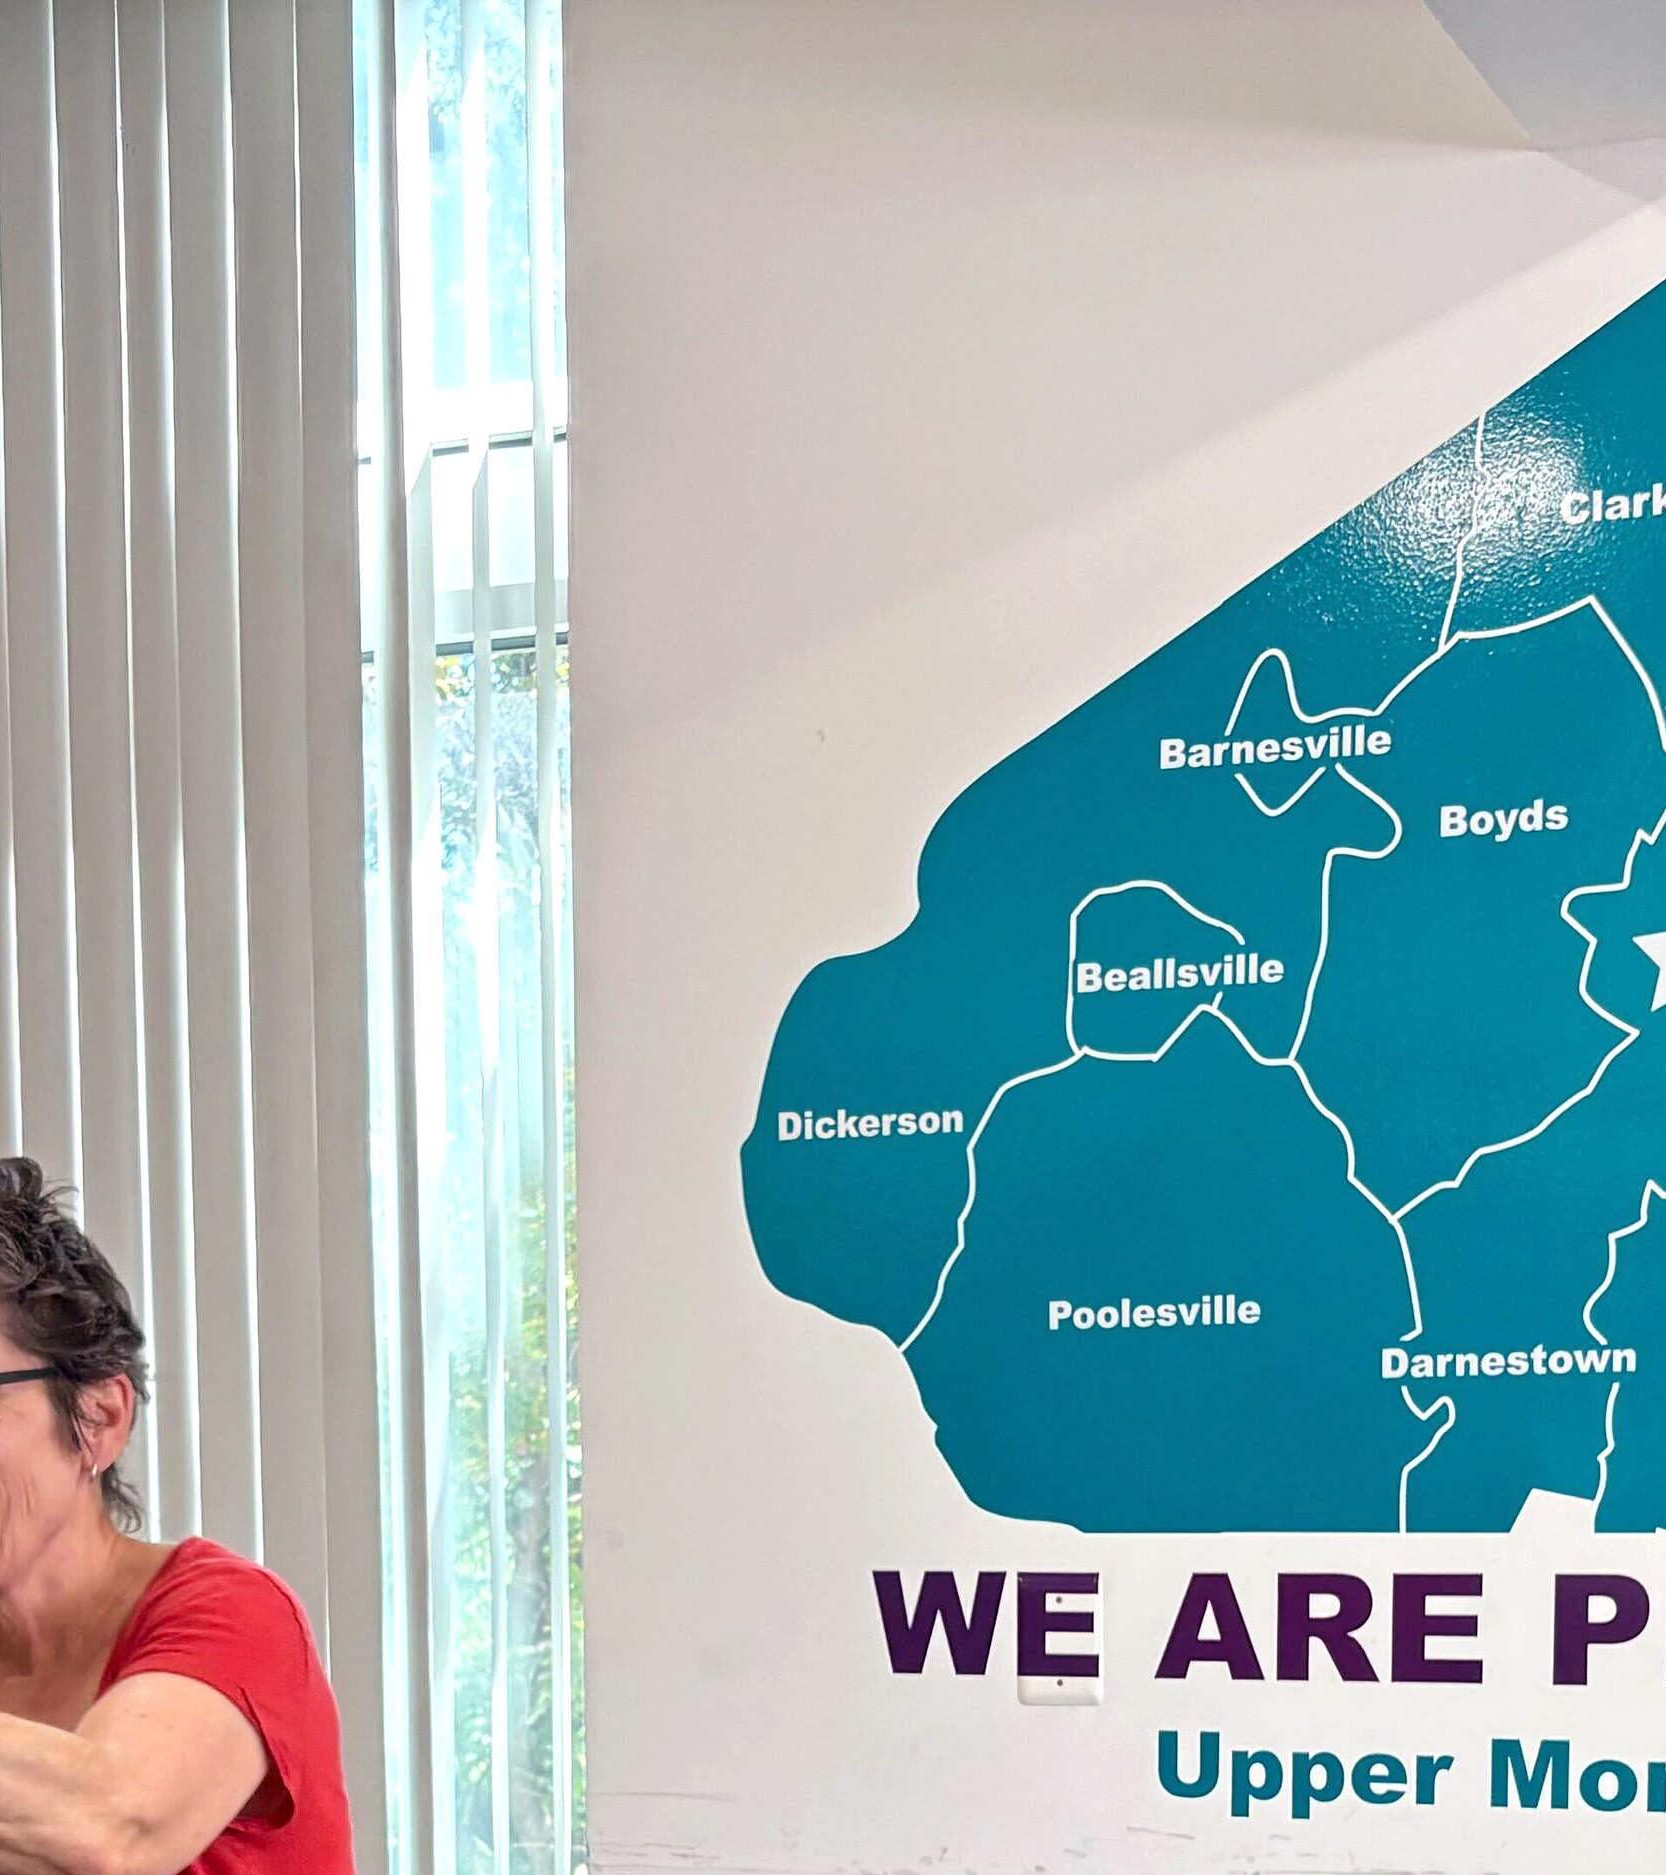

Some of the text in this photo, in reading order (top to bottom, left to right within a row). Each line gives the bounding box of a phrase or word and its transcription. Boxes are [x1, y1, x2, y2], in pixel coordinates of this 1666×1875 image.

[1159, 723, 1393, 771] Barnesville
[1439, 797, 1570, 843] Boyds
[1076, 951, 1285, 994] Beallsville
[777, 1108, 965, 1142] Dickerson
[1048, 1293, 1262, 1331] Poolesville
[1380, 1343, 1638, 1380] Darnestown
[871, 1569, 1101, 1679] WE
[1153, 1572, 1484, 1685] ARE
[1156, 1729, 1456, 1821] Upper
